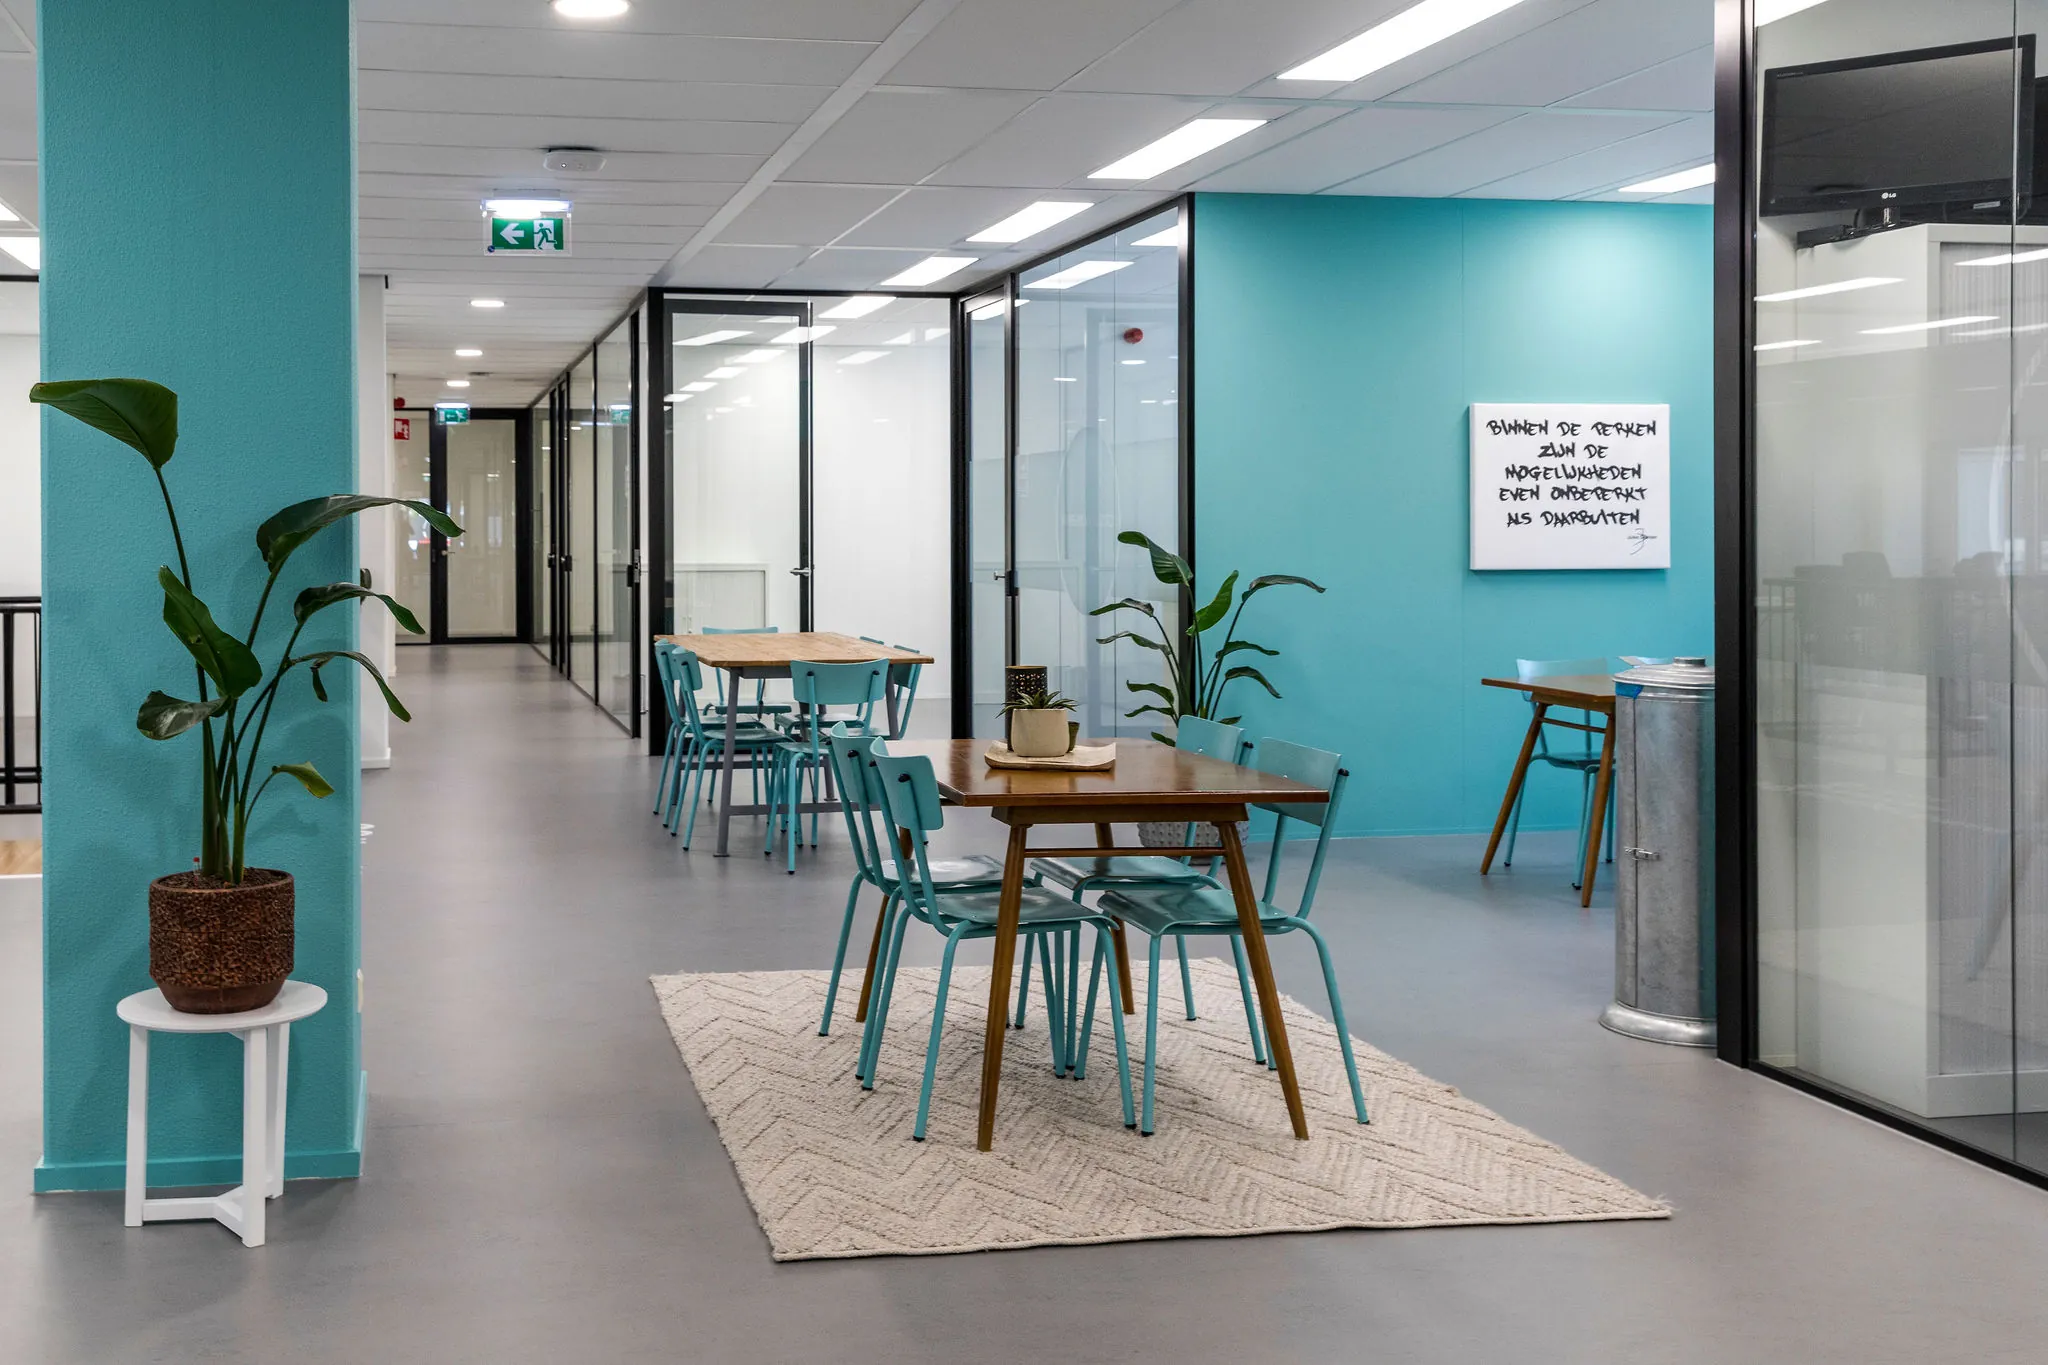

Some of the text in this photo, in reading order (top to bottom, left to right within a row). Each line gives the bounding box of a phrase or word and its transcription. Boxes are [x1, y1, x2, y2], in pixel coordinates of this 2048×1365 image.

[1486, 419, 1656, 438] BINNEN DE PERKEN
[1538, 442, 1608, 458] ZIJN DE
[1505, 464, 1641, 482] MOGELIJKHEDEN
[1499, 485, 1647, 502] EVEN ONBEPERKT
[1507, 509, 1639, 527] ALS DAARBUITEN
